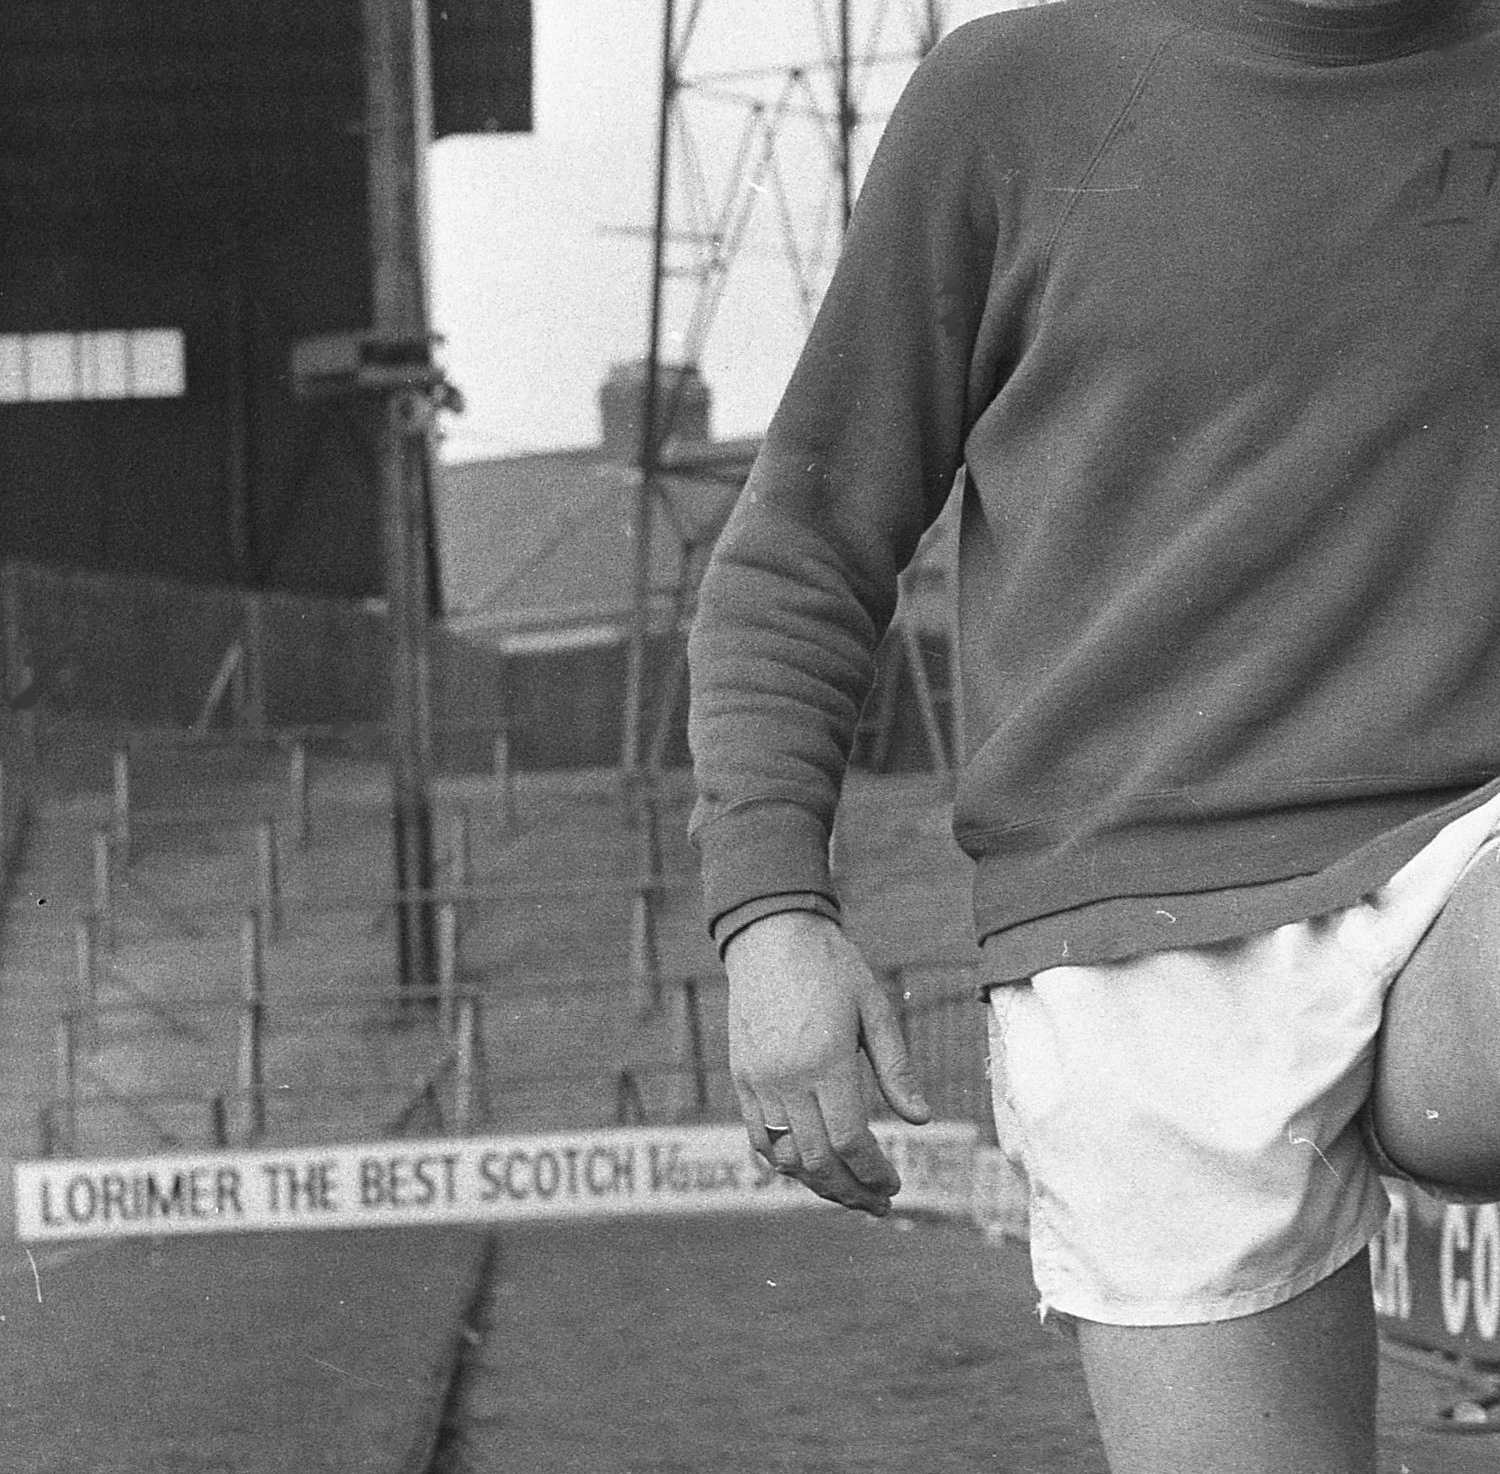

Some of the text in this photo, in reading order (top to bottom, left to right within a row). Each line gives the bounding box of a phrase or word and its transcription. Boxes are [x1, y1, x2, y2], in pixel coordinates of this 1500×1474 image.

[41, 1167, 244, 1226] LORIMER
[263, 1159, 338, 1215] THE
[360, 1154, 461, 1209] BEST
[478, 1145, 635, 1203] SCOTCH
